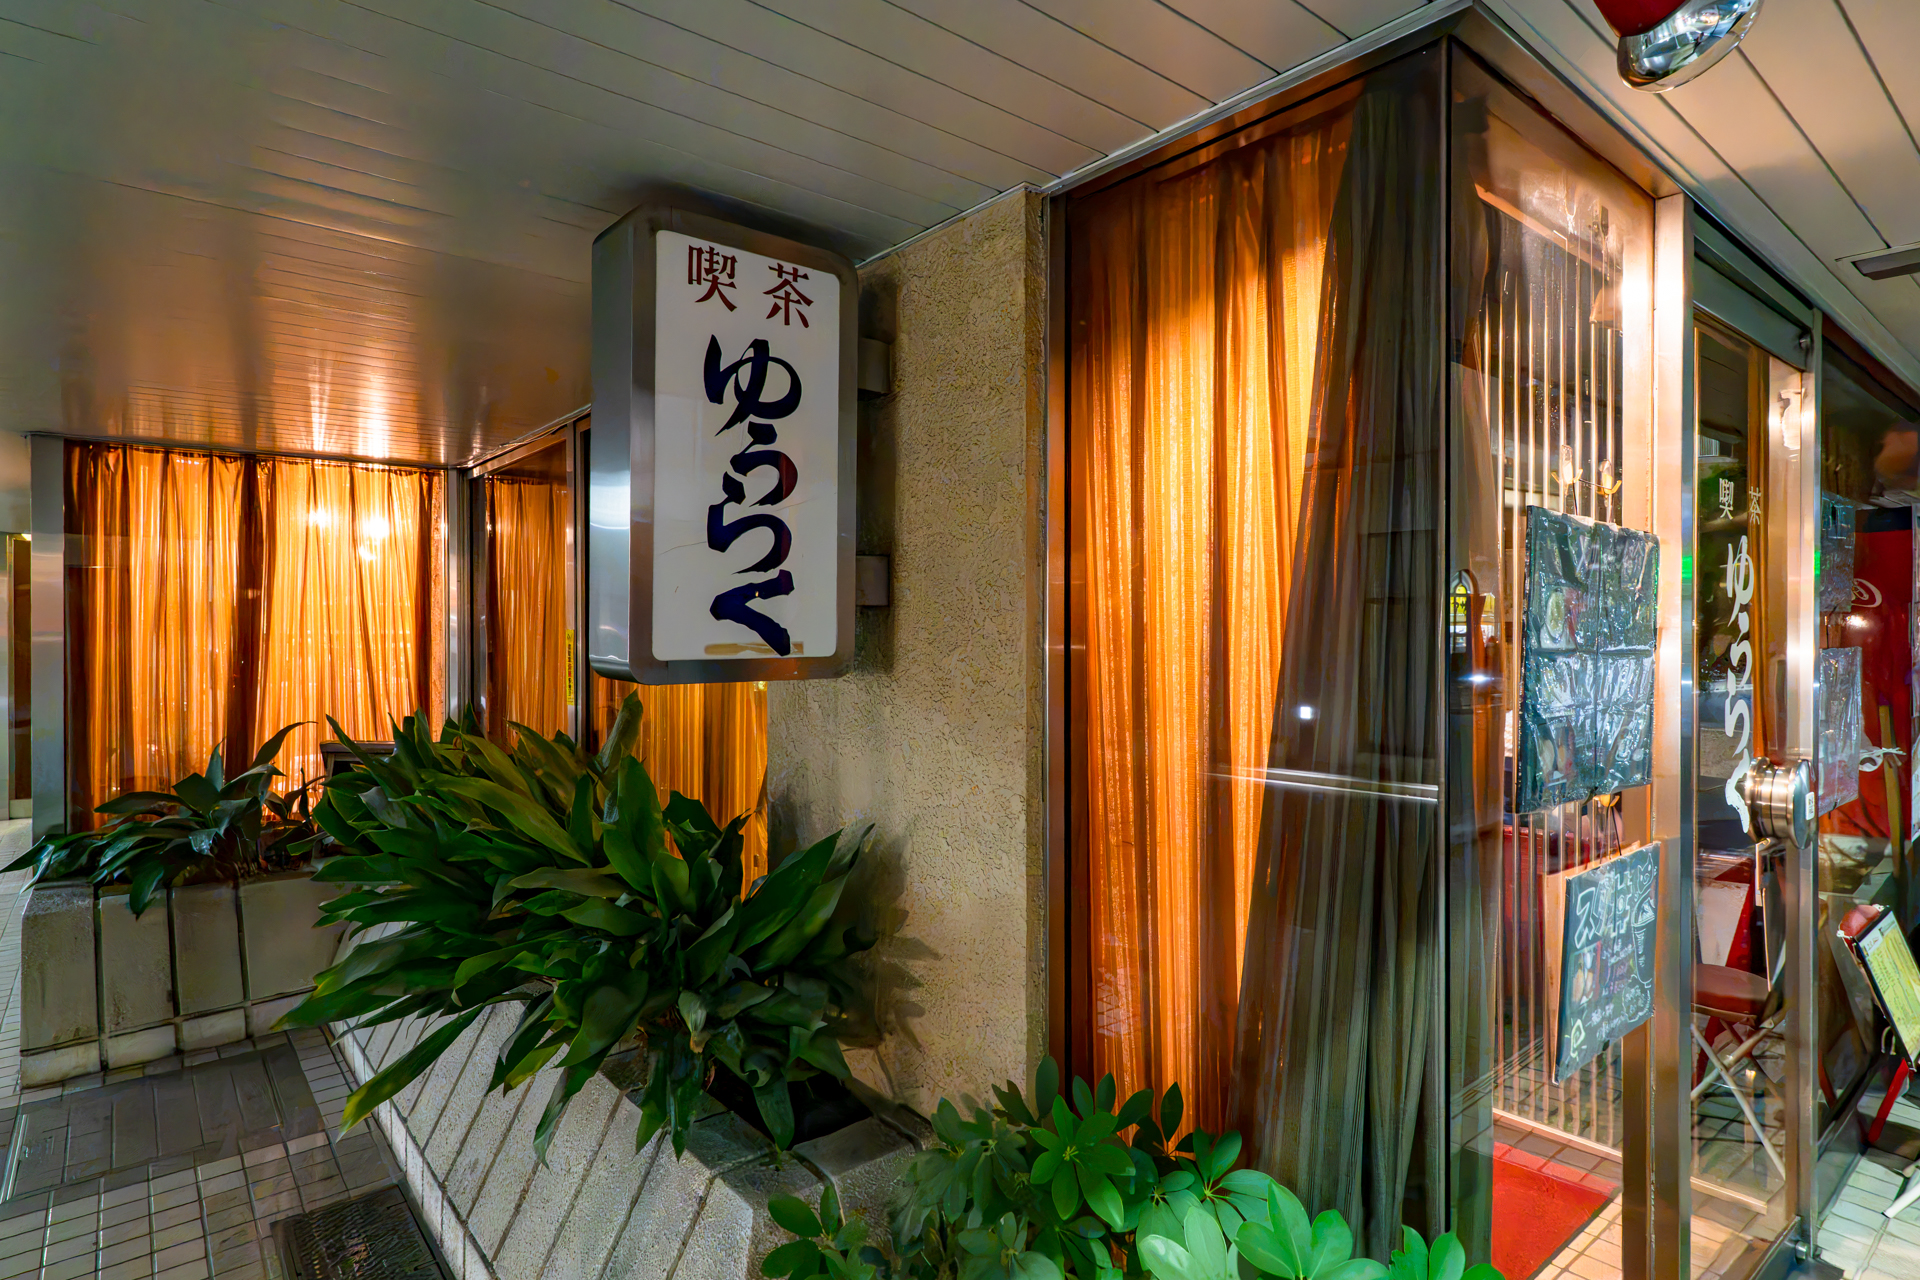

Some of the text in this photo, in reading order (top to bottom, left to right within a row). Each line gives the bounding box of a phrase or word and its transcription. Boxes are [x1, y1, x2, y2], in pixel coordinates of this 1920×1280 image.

[687, 244, 814, 329] 喫茶
[703, 333, 803, 657] ゆうらく
[1718, 477, 1762, 525] 喫茶
[1725, 534, 1755, 834] ゆうらく
